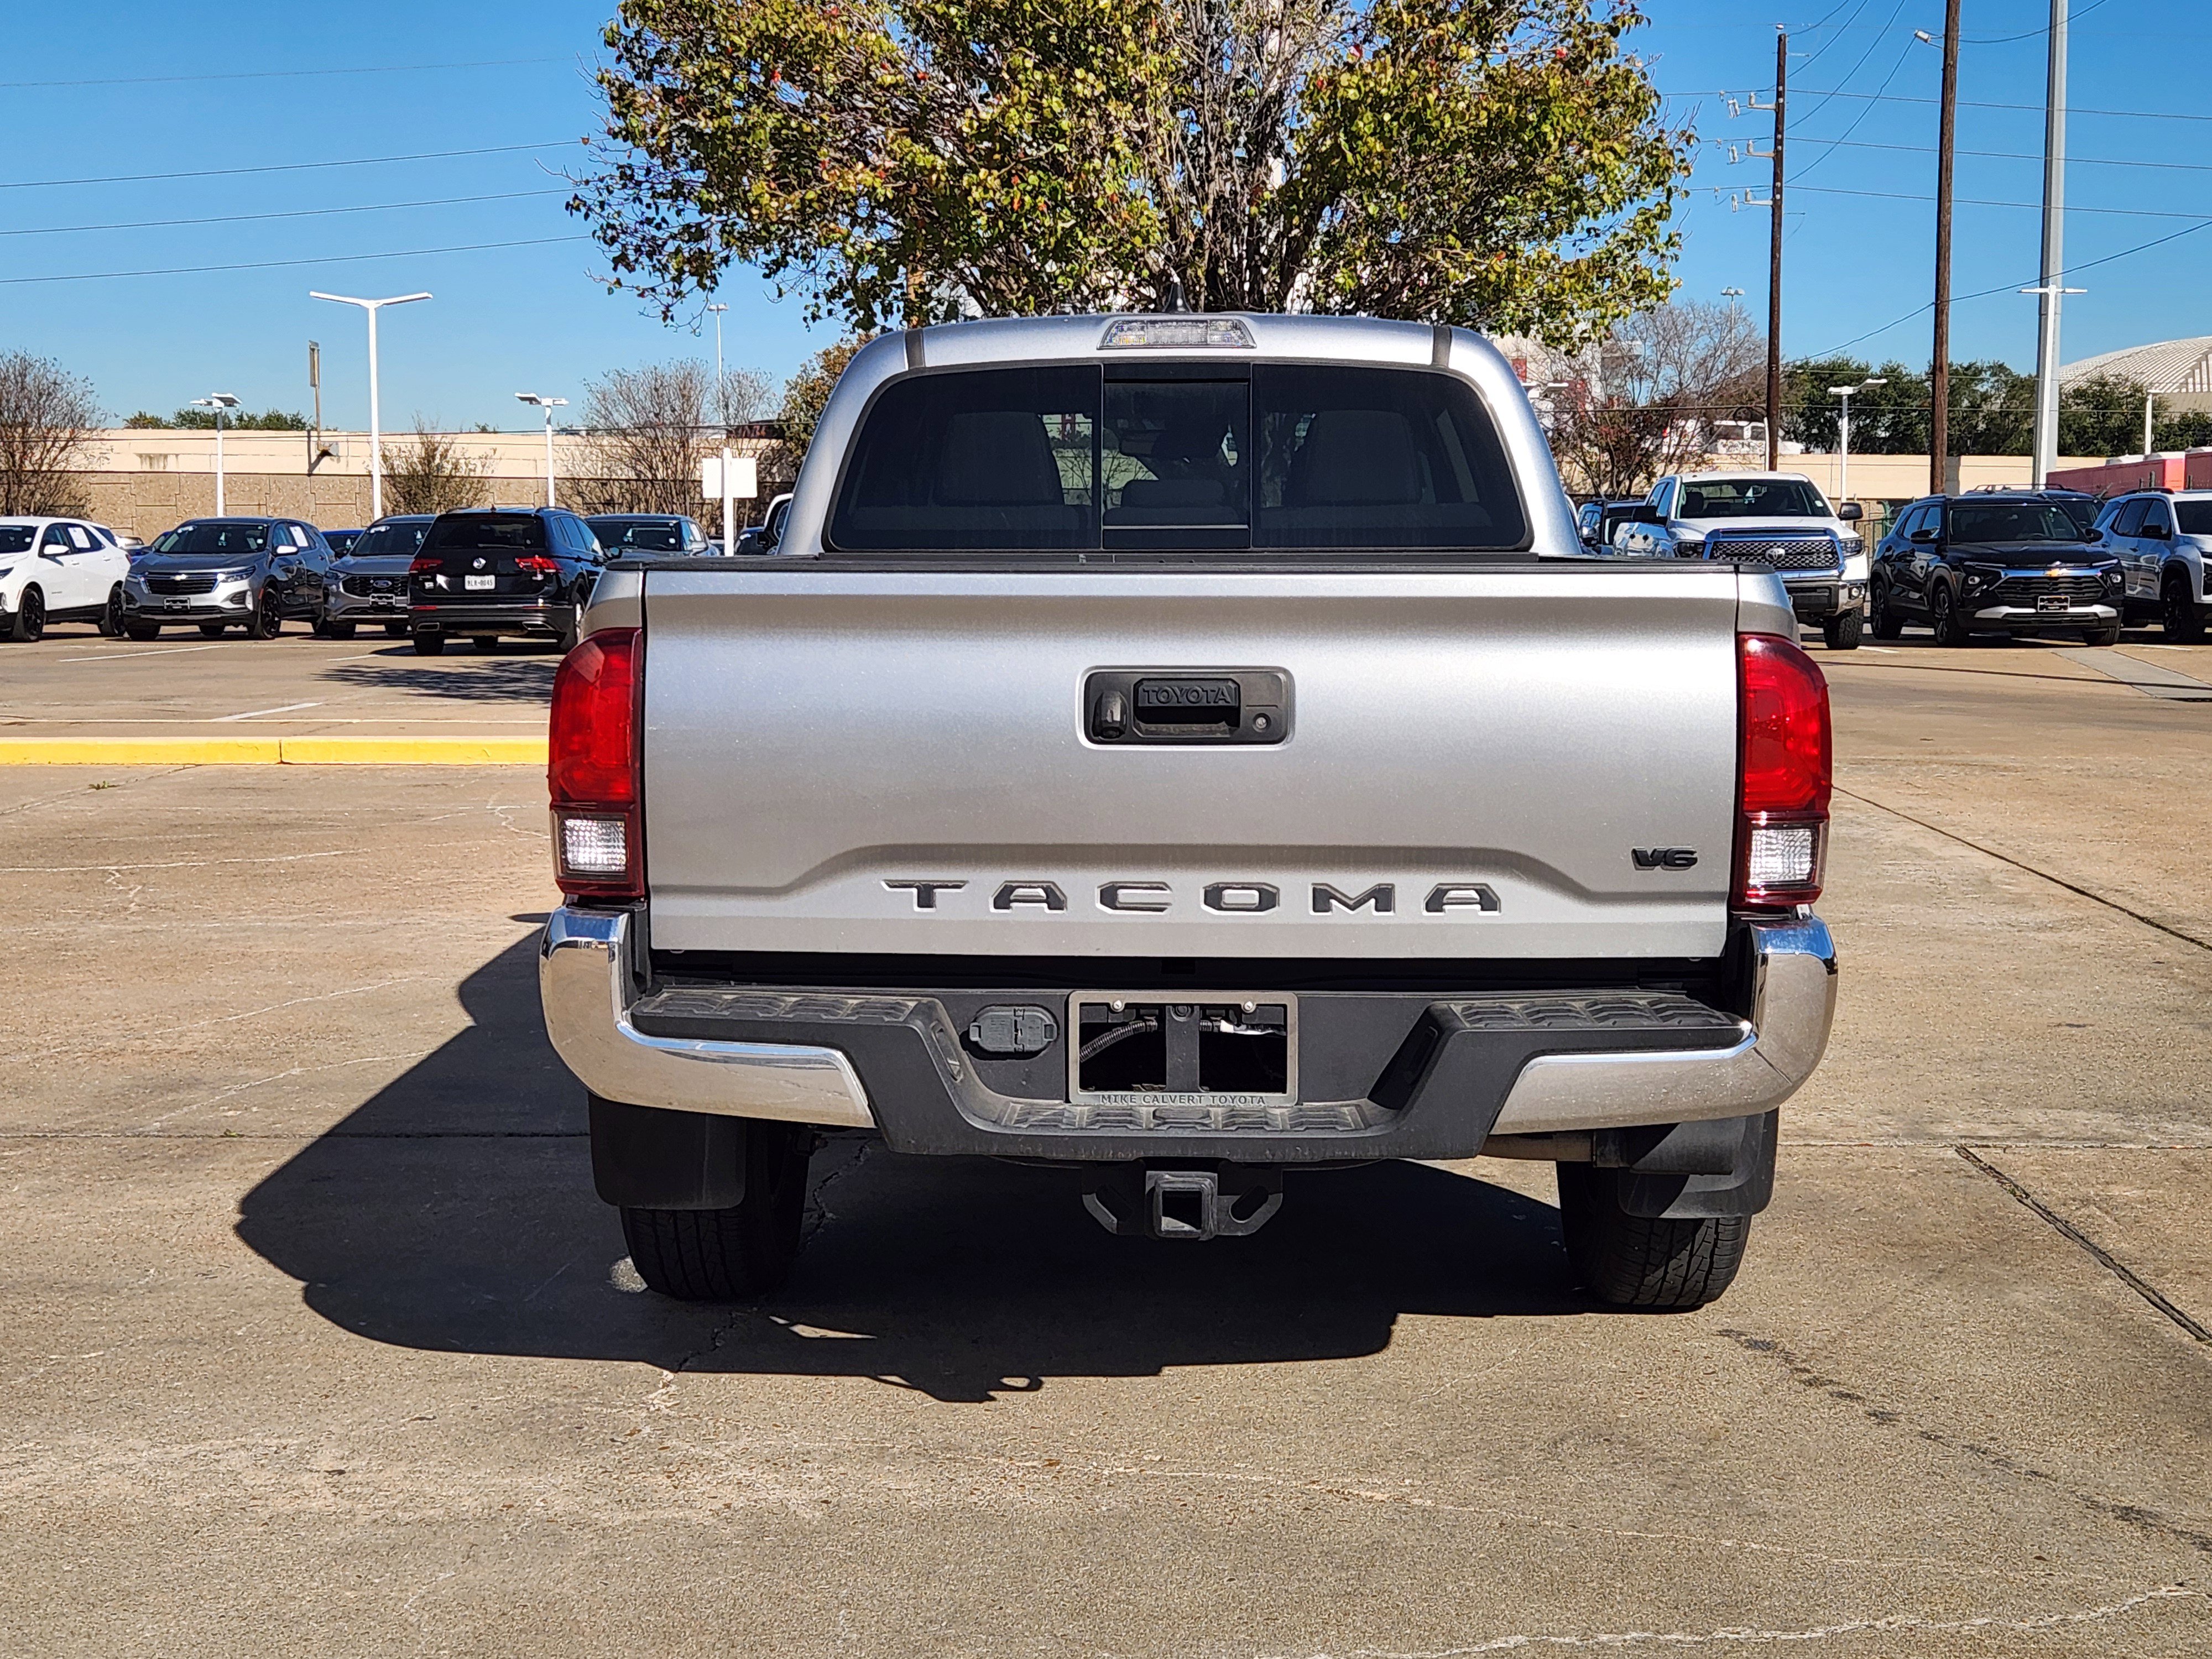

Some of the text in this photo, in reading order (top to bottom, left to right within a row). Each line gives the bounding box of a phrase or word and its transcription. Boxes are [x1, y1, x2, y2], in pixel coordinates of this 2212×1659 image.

[1142, 686, 1232, 705] TOYOTA
[1631, 846, 1698, 870] V6
[881, 879, 1502, 916] TACOMA
[1100, 1094, 1266, 1105] MIKE CALVERT TOYOTA
